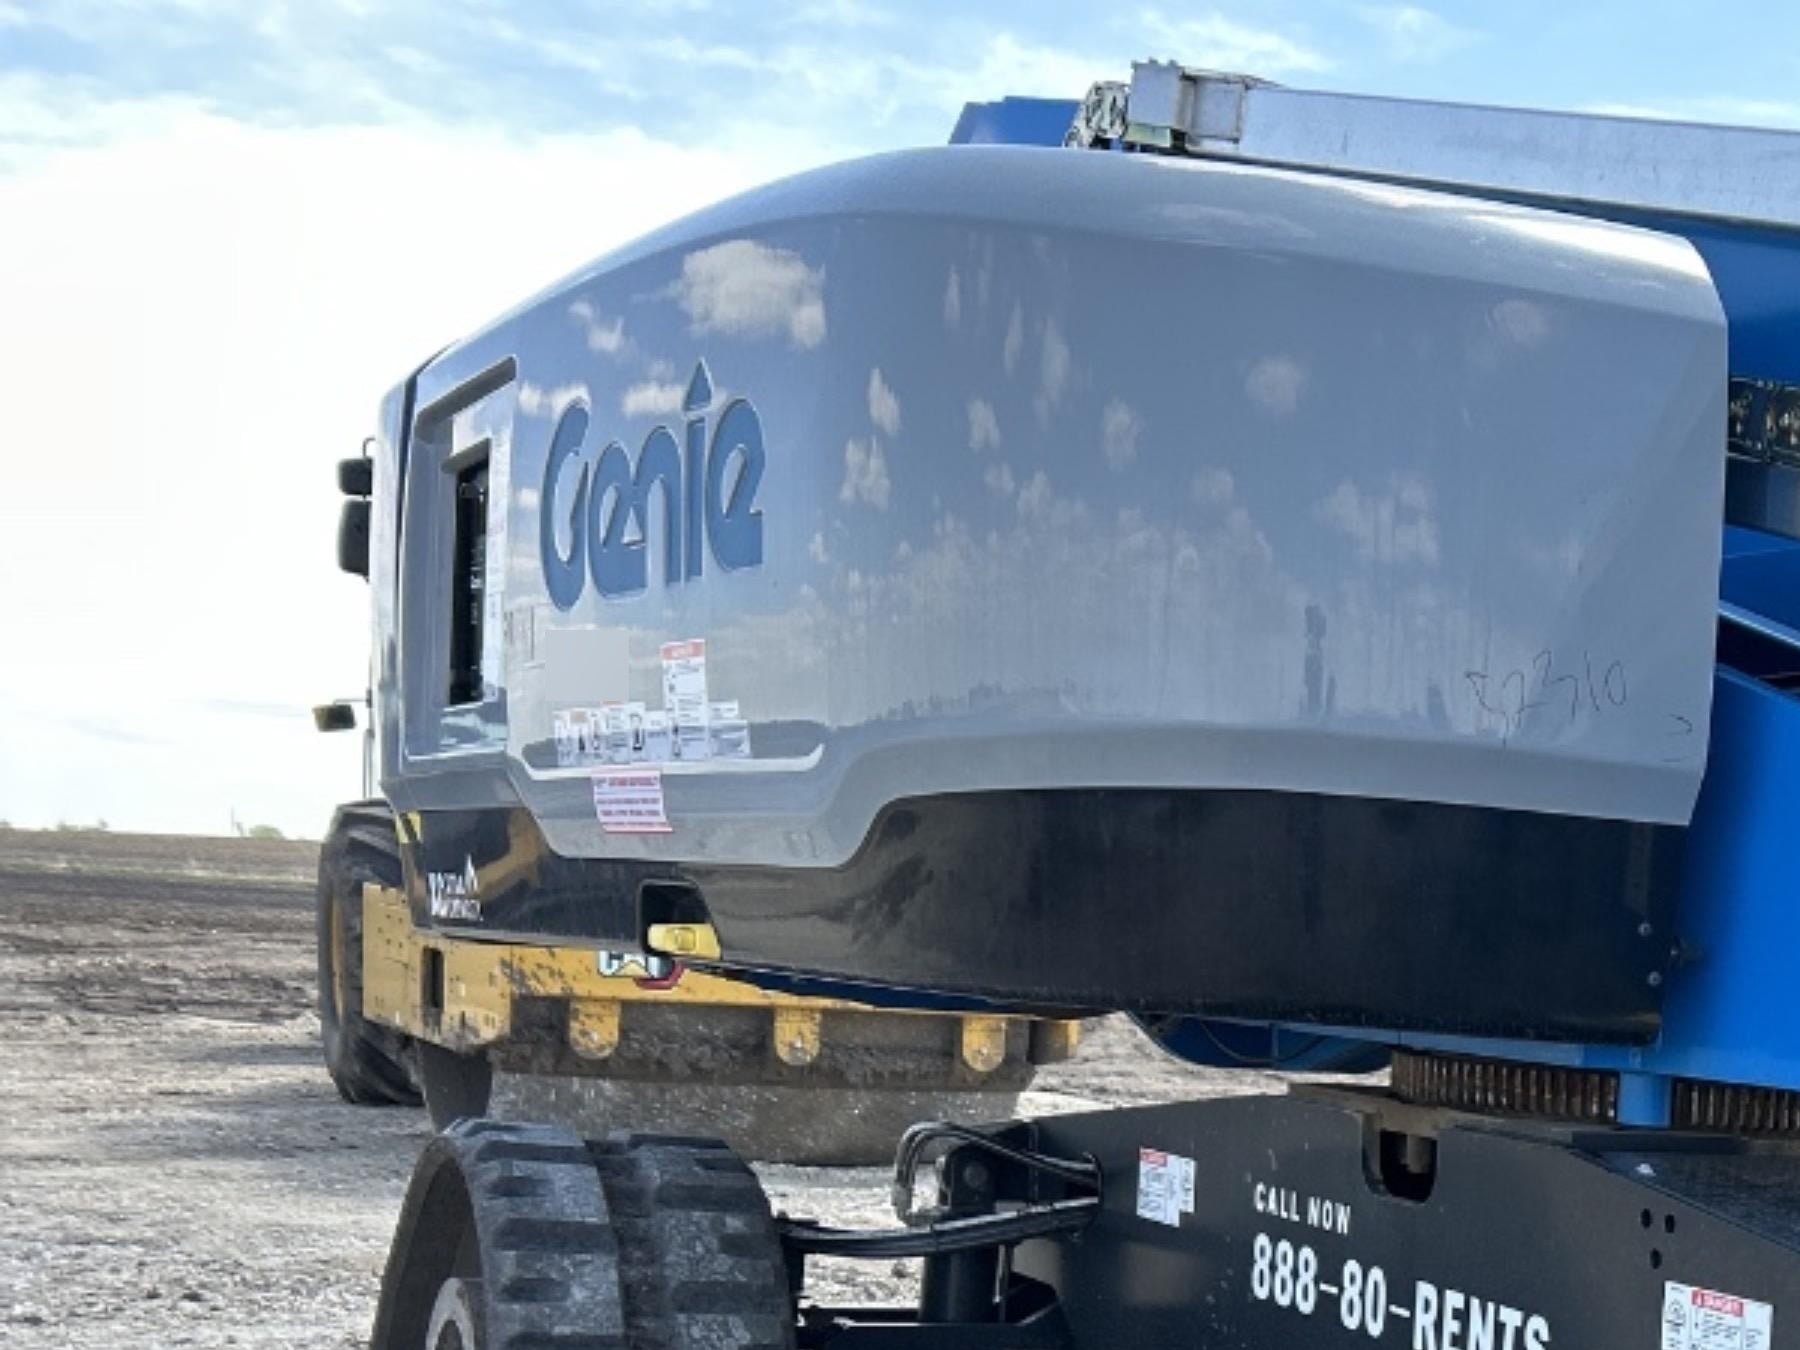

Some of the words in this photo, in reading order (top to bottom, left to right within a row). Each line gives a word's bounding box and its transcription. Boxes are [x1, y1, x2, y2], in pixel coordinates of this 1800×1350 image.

[539, 356, 768, 614] Genie
[1253, 1181, 1301, 1223] CALL
[1306, 1196, 1351, 1236] NOW
